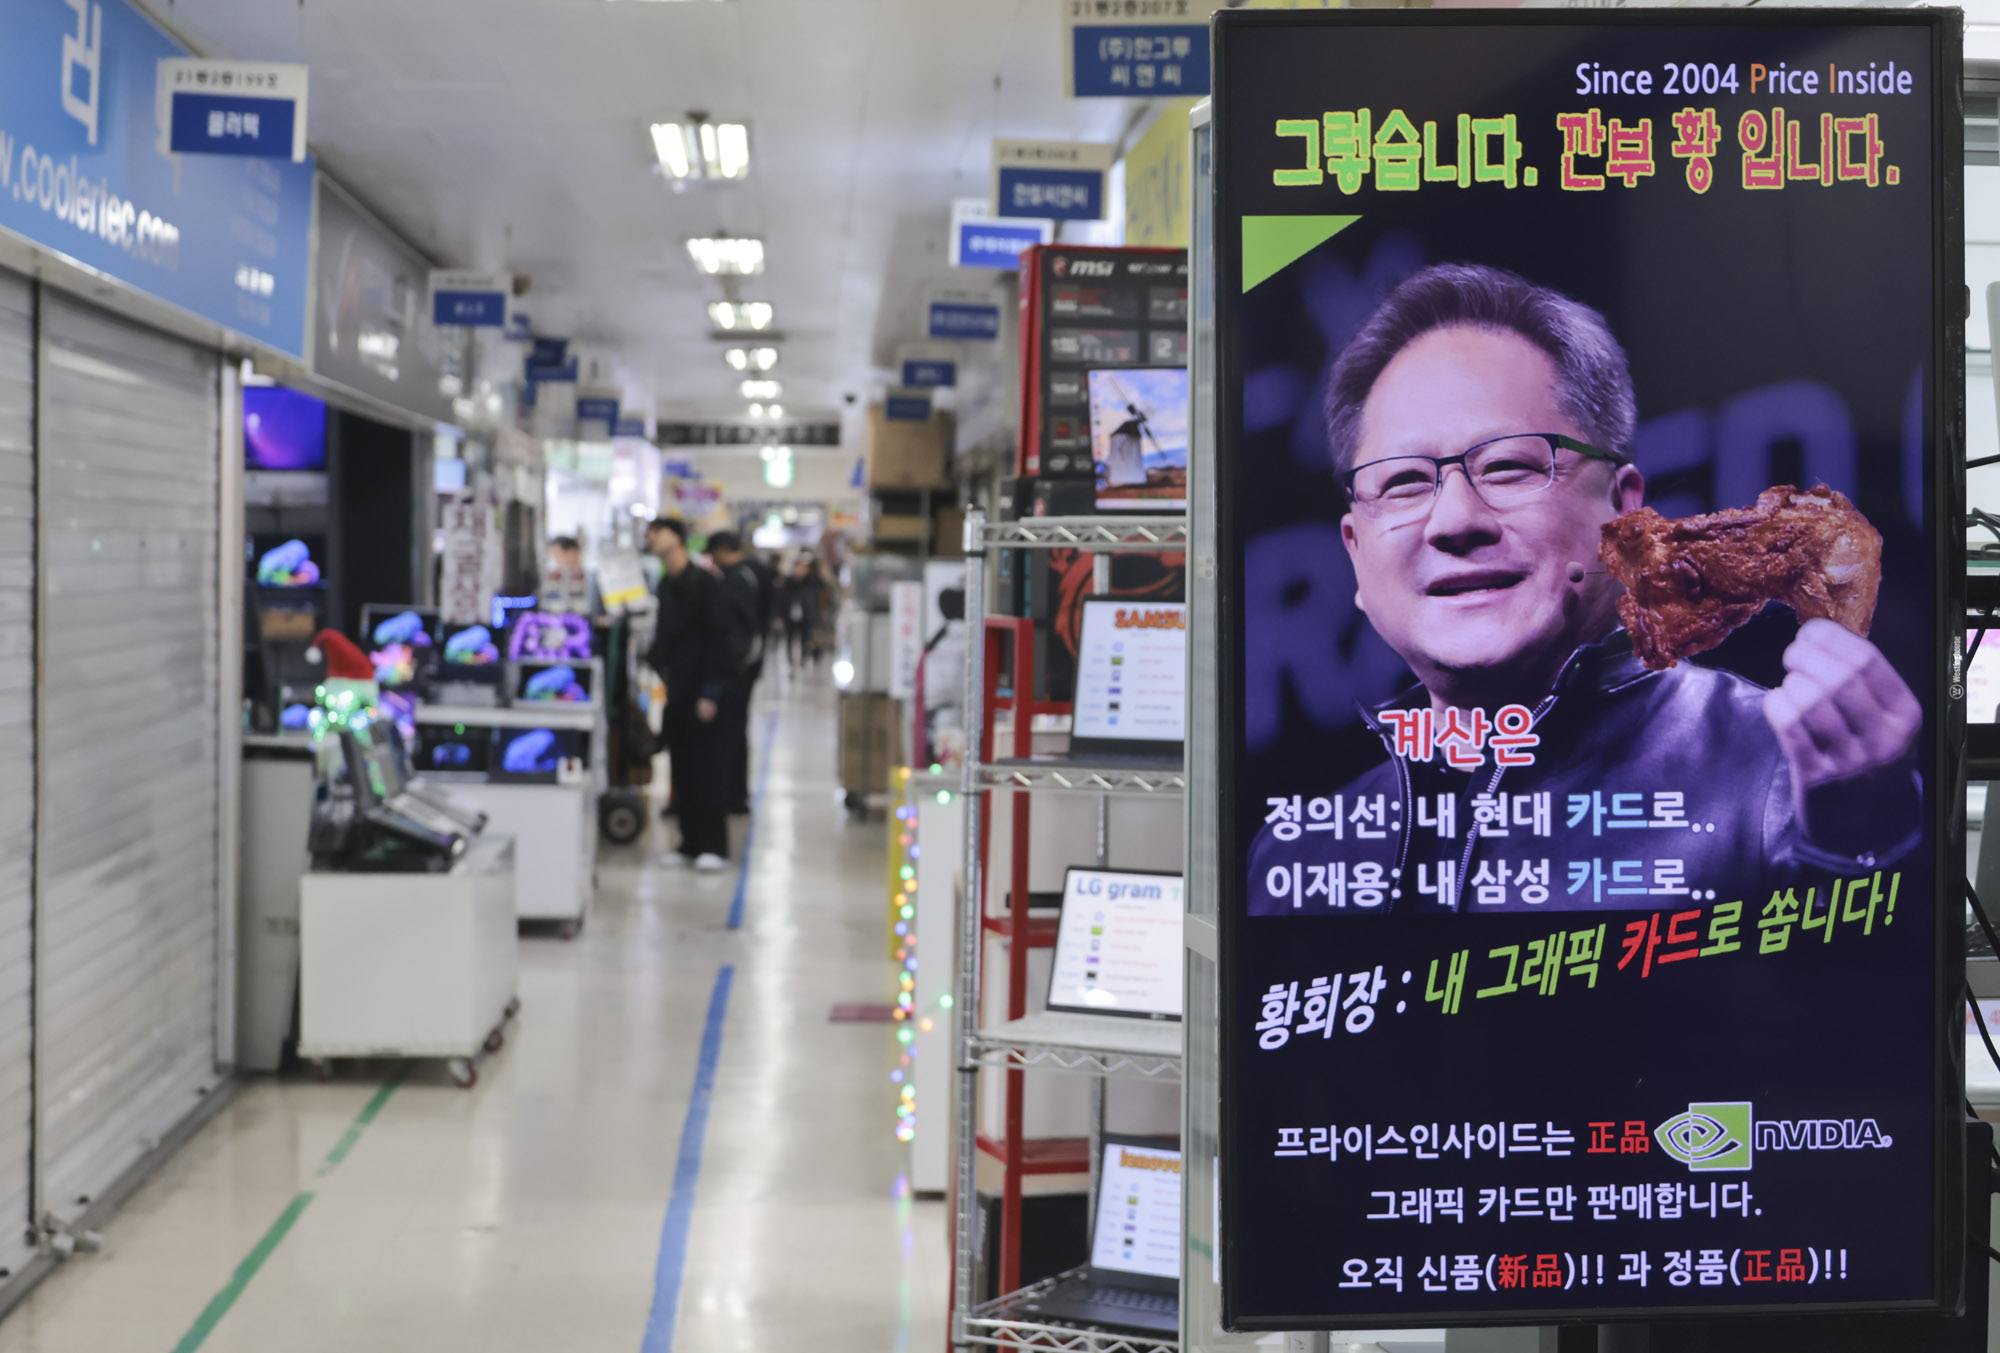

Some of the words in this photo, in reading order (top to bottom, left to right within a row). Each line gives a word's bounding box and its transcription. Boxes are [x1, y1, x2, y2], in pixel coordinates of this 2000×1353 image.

[1575, 61, 1654, 96] Since
[1662, 62, 1740, 95] 2004
[1750, 61, 1820, 95] Price
[1829, 60, 1914, 95] Inside
[1272, 107, 1539, 195] 그렇습니다.
[1556, 107, 1656, 192] 깐부
[1671, 106, 1722, 195] 황
[1737, 106, 1901, 191] 입니다.
[1952, 635, 1962, 683] Westinghouse
[1378, 706, 1540, 767] 계산은
[1265, 794, 1401, 842] 정의선:
[1417, 793, 1456, 838] 내
[1470, 791, 1551, 837] 현대
[1566, 791, 1715, 836] 카드로..
[1076, 877, 1103, 895] LG
[1108, 881, 1162, 901] gram
[1266, 861, 1401, 908] 이재용:
[1417, 860, 1456, 906] 내
[1470, 858, 1550, 904] 삼성
[1566, 858, 1715, 903] 카드로..
[1425, 949, 1469, 1014] 내
[1476, 923, 1606, 999] 그래픽
[1617, 901, 1743, 978] 카드로
[1757, 871, 1901, 954] 쏩니다!
[1273, 1121, 1576, 1163] 프라이스인사이드는
[1586, 1120, 1650, 1155] 正品
[1366, 1186, 1465, 1225] 그래픽
[1477, 1184, 1578, 1223] 카드만
[1587, 1180, 1763, 1221] 판매합니다.
[1338, 1255, 1404, 1293] 오직
[1617, 1250, 1653, 1288] 과
[1662, 1246, 1848, 1287] 정품(正品)!!
